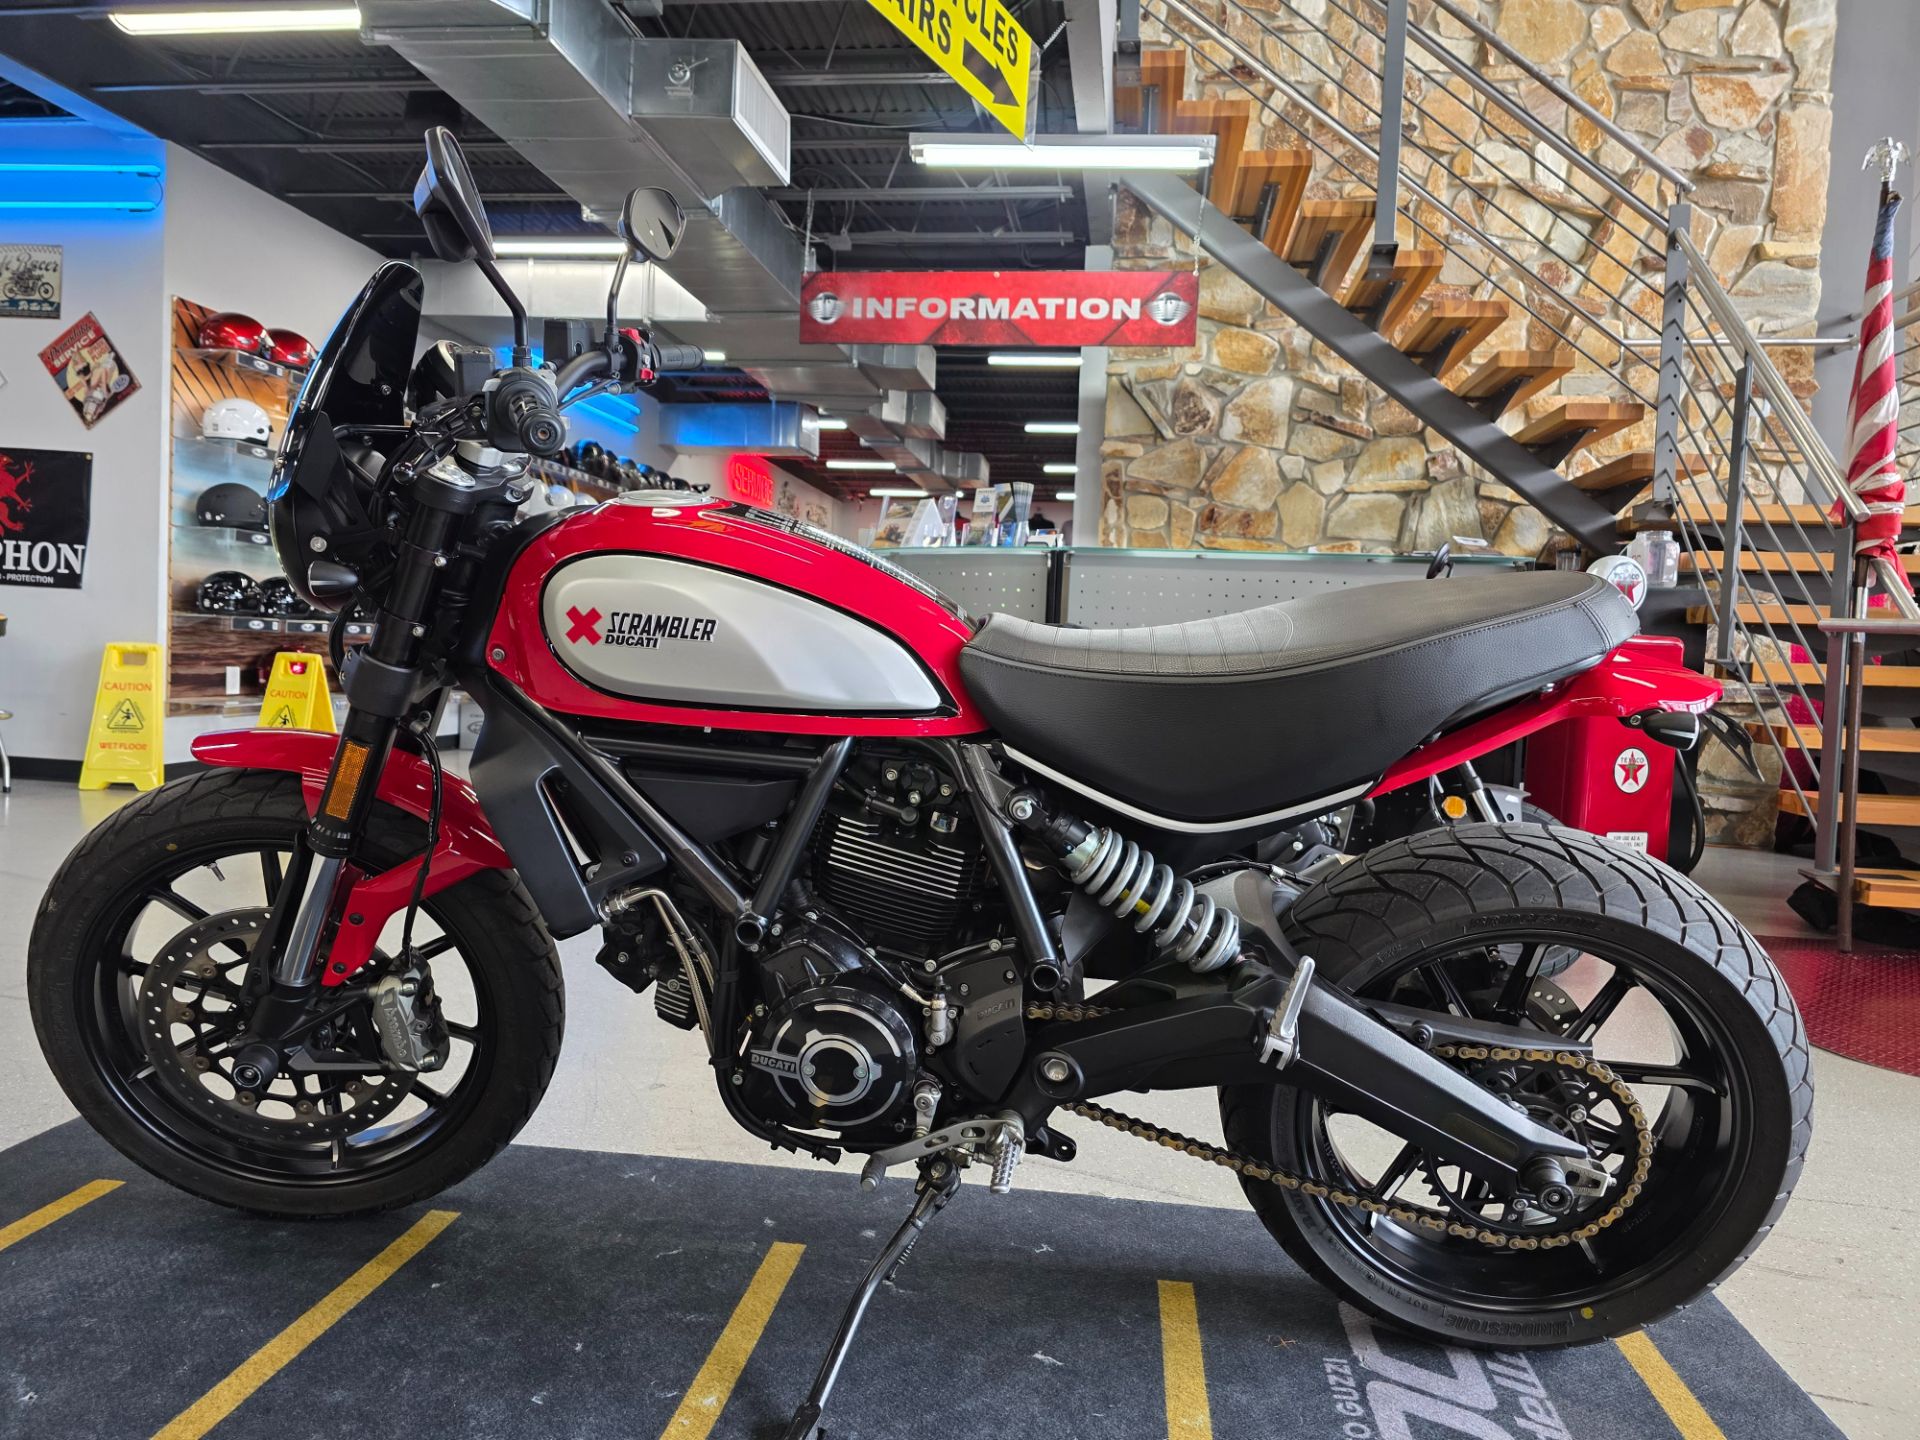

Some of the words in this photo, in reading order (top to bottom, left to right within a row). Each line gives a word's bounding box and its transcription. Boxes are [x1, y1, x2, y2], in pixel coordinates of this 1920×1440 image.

[952, 0, 1018, 67] CLES
[851, 296, 1141, 321] INFORMATION
[53, 330, 96, 368] SERVICE
[0, 539, 86, 575] HON
[6, 573, 54, 584] PROTECTION
[607, 611, 717, 642] SCRAMBLER
[605, 634, 659, 648] DUCATI
[103, 682, 152, 692] CAUTION
[270, 689, 309, 699] CAUTION
[99, 742, 116, 750] WET
[117, 742, 148, 751] FLOOR
[751, 1055, 796, 1073] DUCATI
[1444, 1313, 1571, 1337] BRIDGESTONE
[1323, 1357, 1365, 1418] GUZZI
